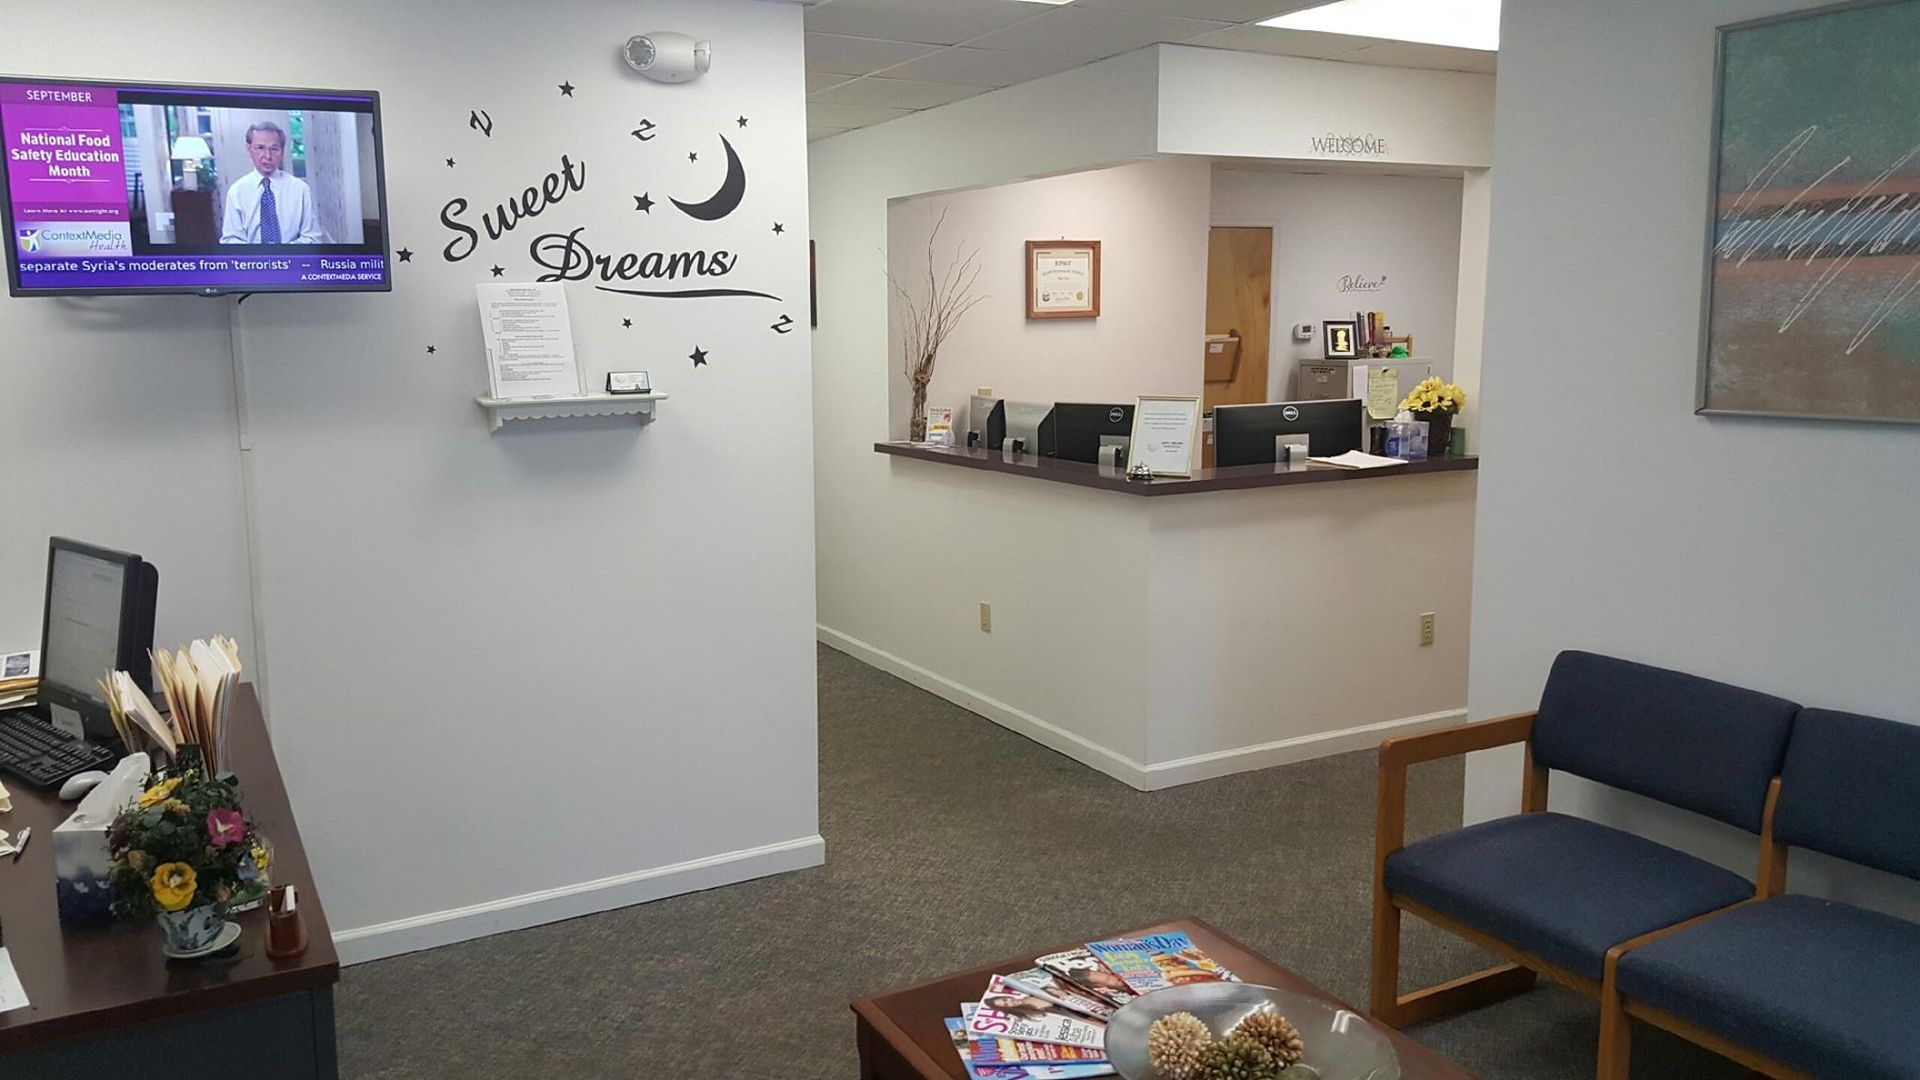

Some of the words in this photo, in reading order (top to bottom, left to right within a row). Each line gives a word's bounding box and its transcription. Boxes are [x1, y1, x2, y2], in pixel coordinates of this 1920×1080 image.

[27, 90, 92, 102] SEPTEMBER
[21, 132, 76, 146] National
[78, 134, 111, 147] Food
[1311, 135, 1385, 154] WELCOME
[11, 148, 52, 164] Safety
[55, 149, 120, 162] Education
[49, 165, 91, 177] Month
[440, 154, 585, 262] Sweet
[41, 229, 122, 241] ContextMedia
[90, 240, 129, 251] Health
[529, 227, 738, 283] Dreams
[20, 261, 78, 273] separate
[82, 260, 126, 273] Syria's
[129, 260, 196, 271] moderates
[199, 259, 229, 270] from
[231, 259, 291, 270] 'terrorists'
[320, 259, 357, 270] Russia
